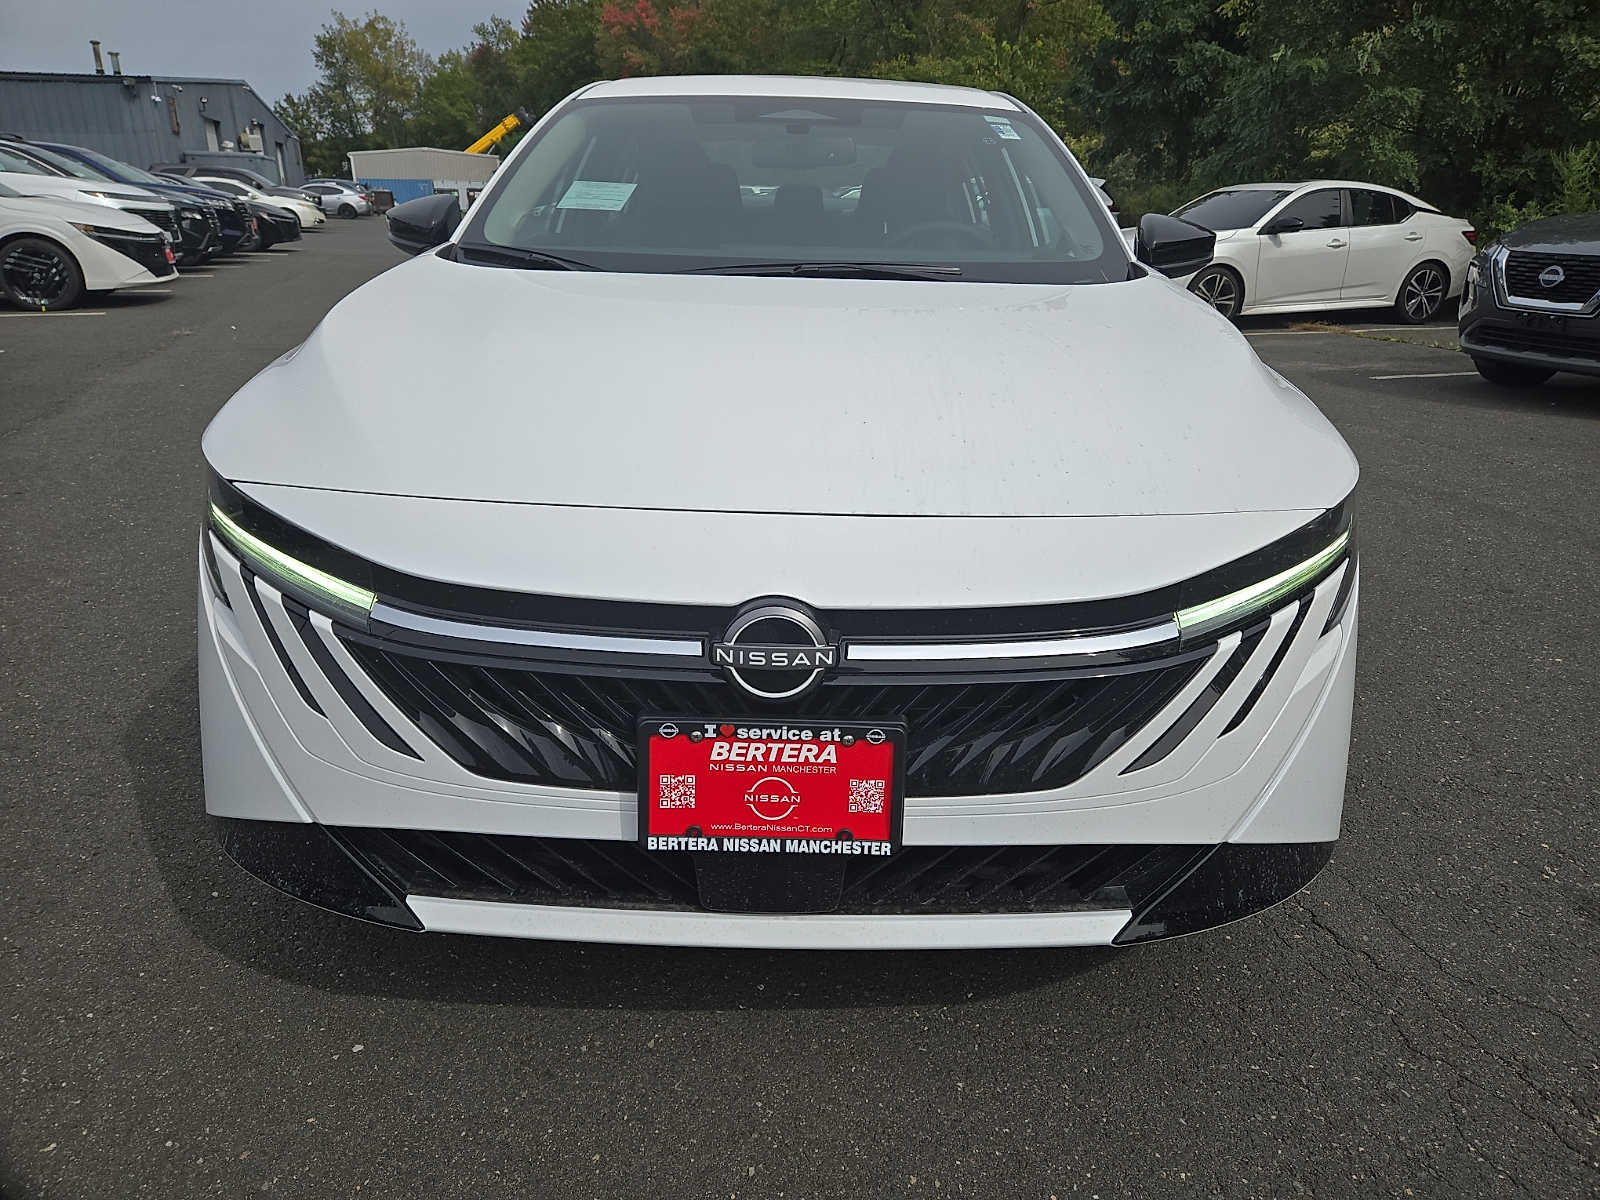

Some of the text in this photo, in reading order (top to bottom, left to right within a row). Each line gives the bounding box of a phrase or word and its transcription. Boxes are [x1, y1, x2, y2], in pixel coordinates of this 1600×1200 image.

[716, 649, 833, 666] NISSAN
[704, 724, 842, 742] I service at
[709, 741, 838, 764] BERTERA
[709, 763, 837, 774] NISSAN MANCHESTER
[744, 794, 801, 803] NISSAN
[710, 822, 833, 833] www.BerteraNissanCT.com
[647, 837, 892, 856] BERTERA NISSAN MANCHESTER
